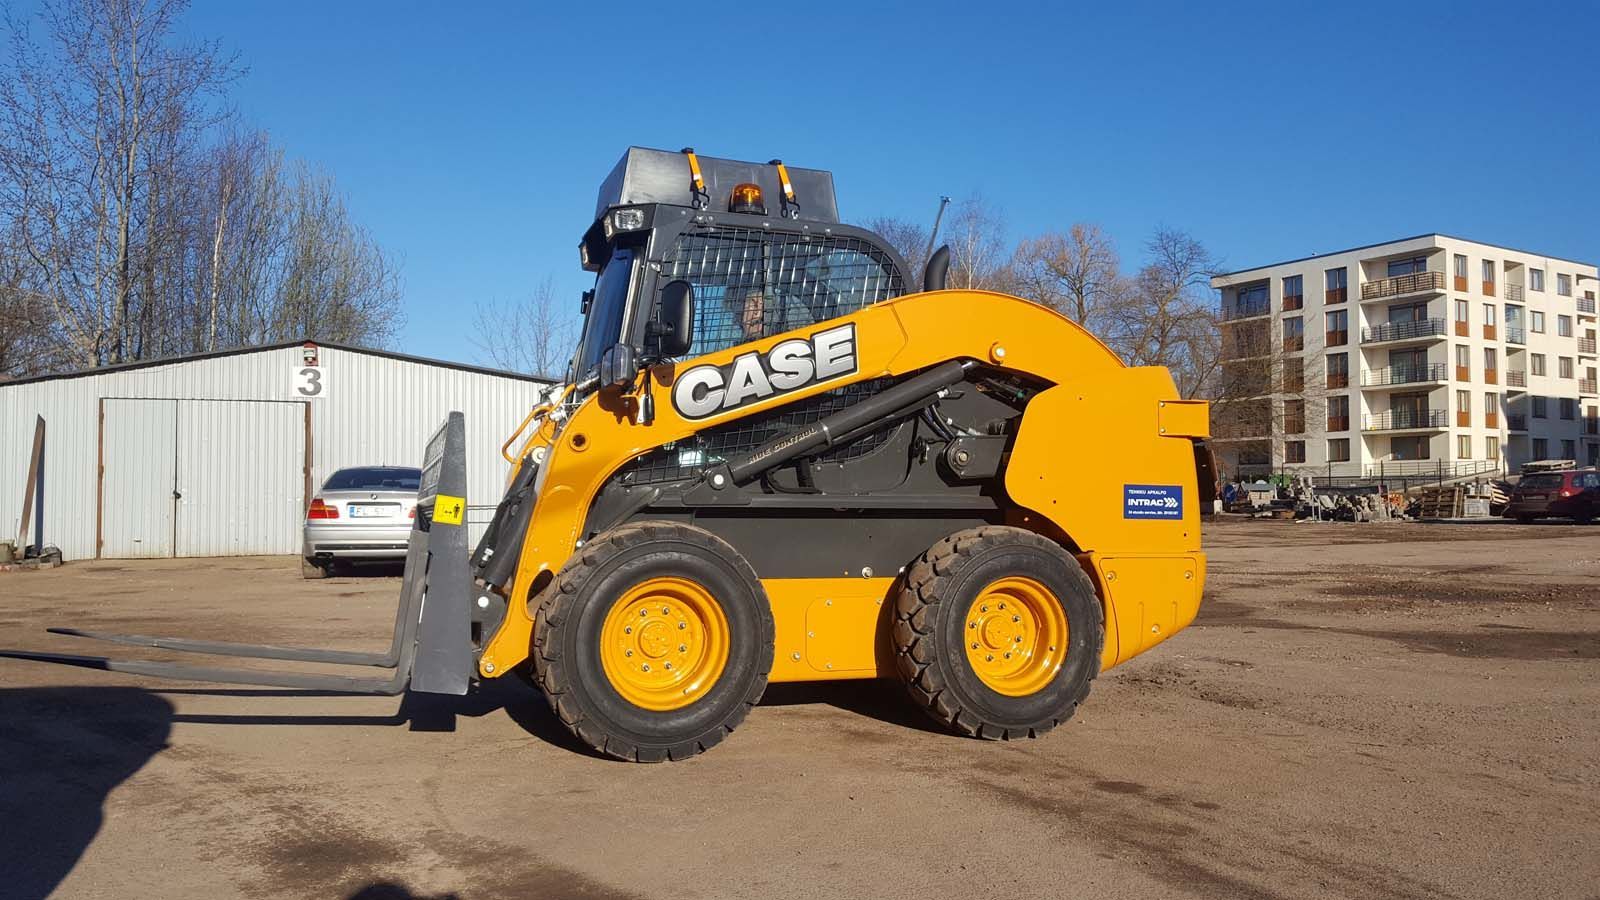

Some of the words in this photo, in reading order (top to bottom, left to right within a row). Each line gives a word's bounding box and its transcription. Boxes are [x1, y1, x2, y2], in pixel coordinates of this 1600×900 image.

[297, 368, 322, 396] 3
[673, 323, 857, 418] CASE
[1128, 498, 1164, 507] INTRAC
